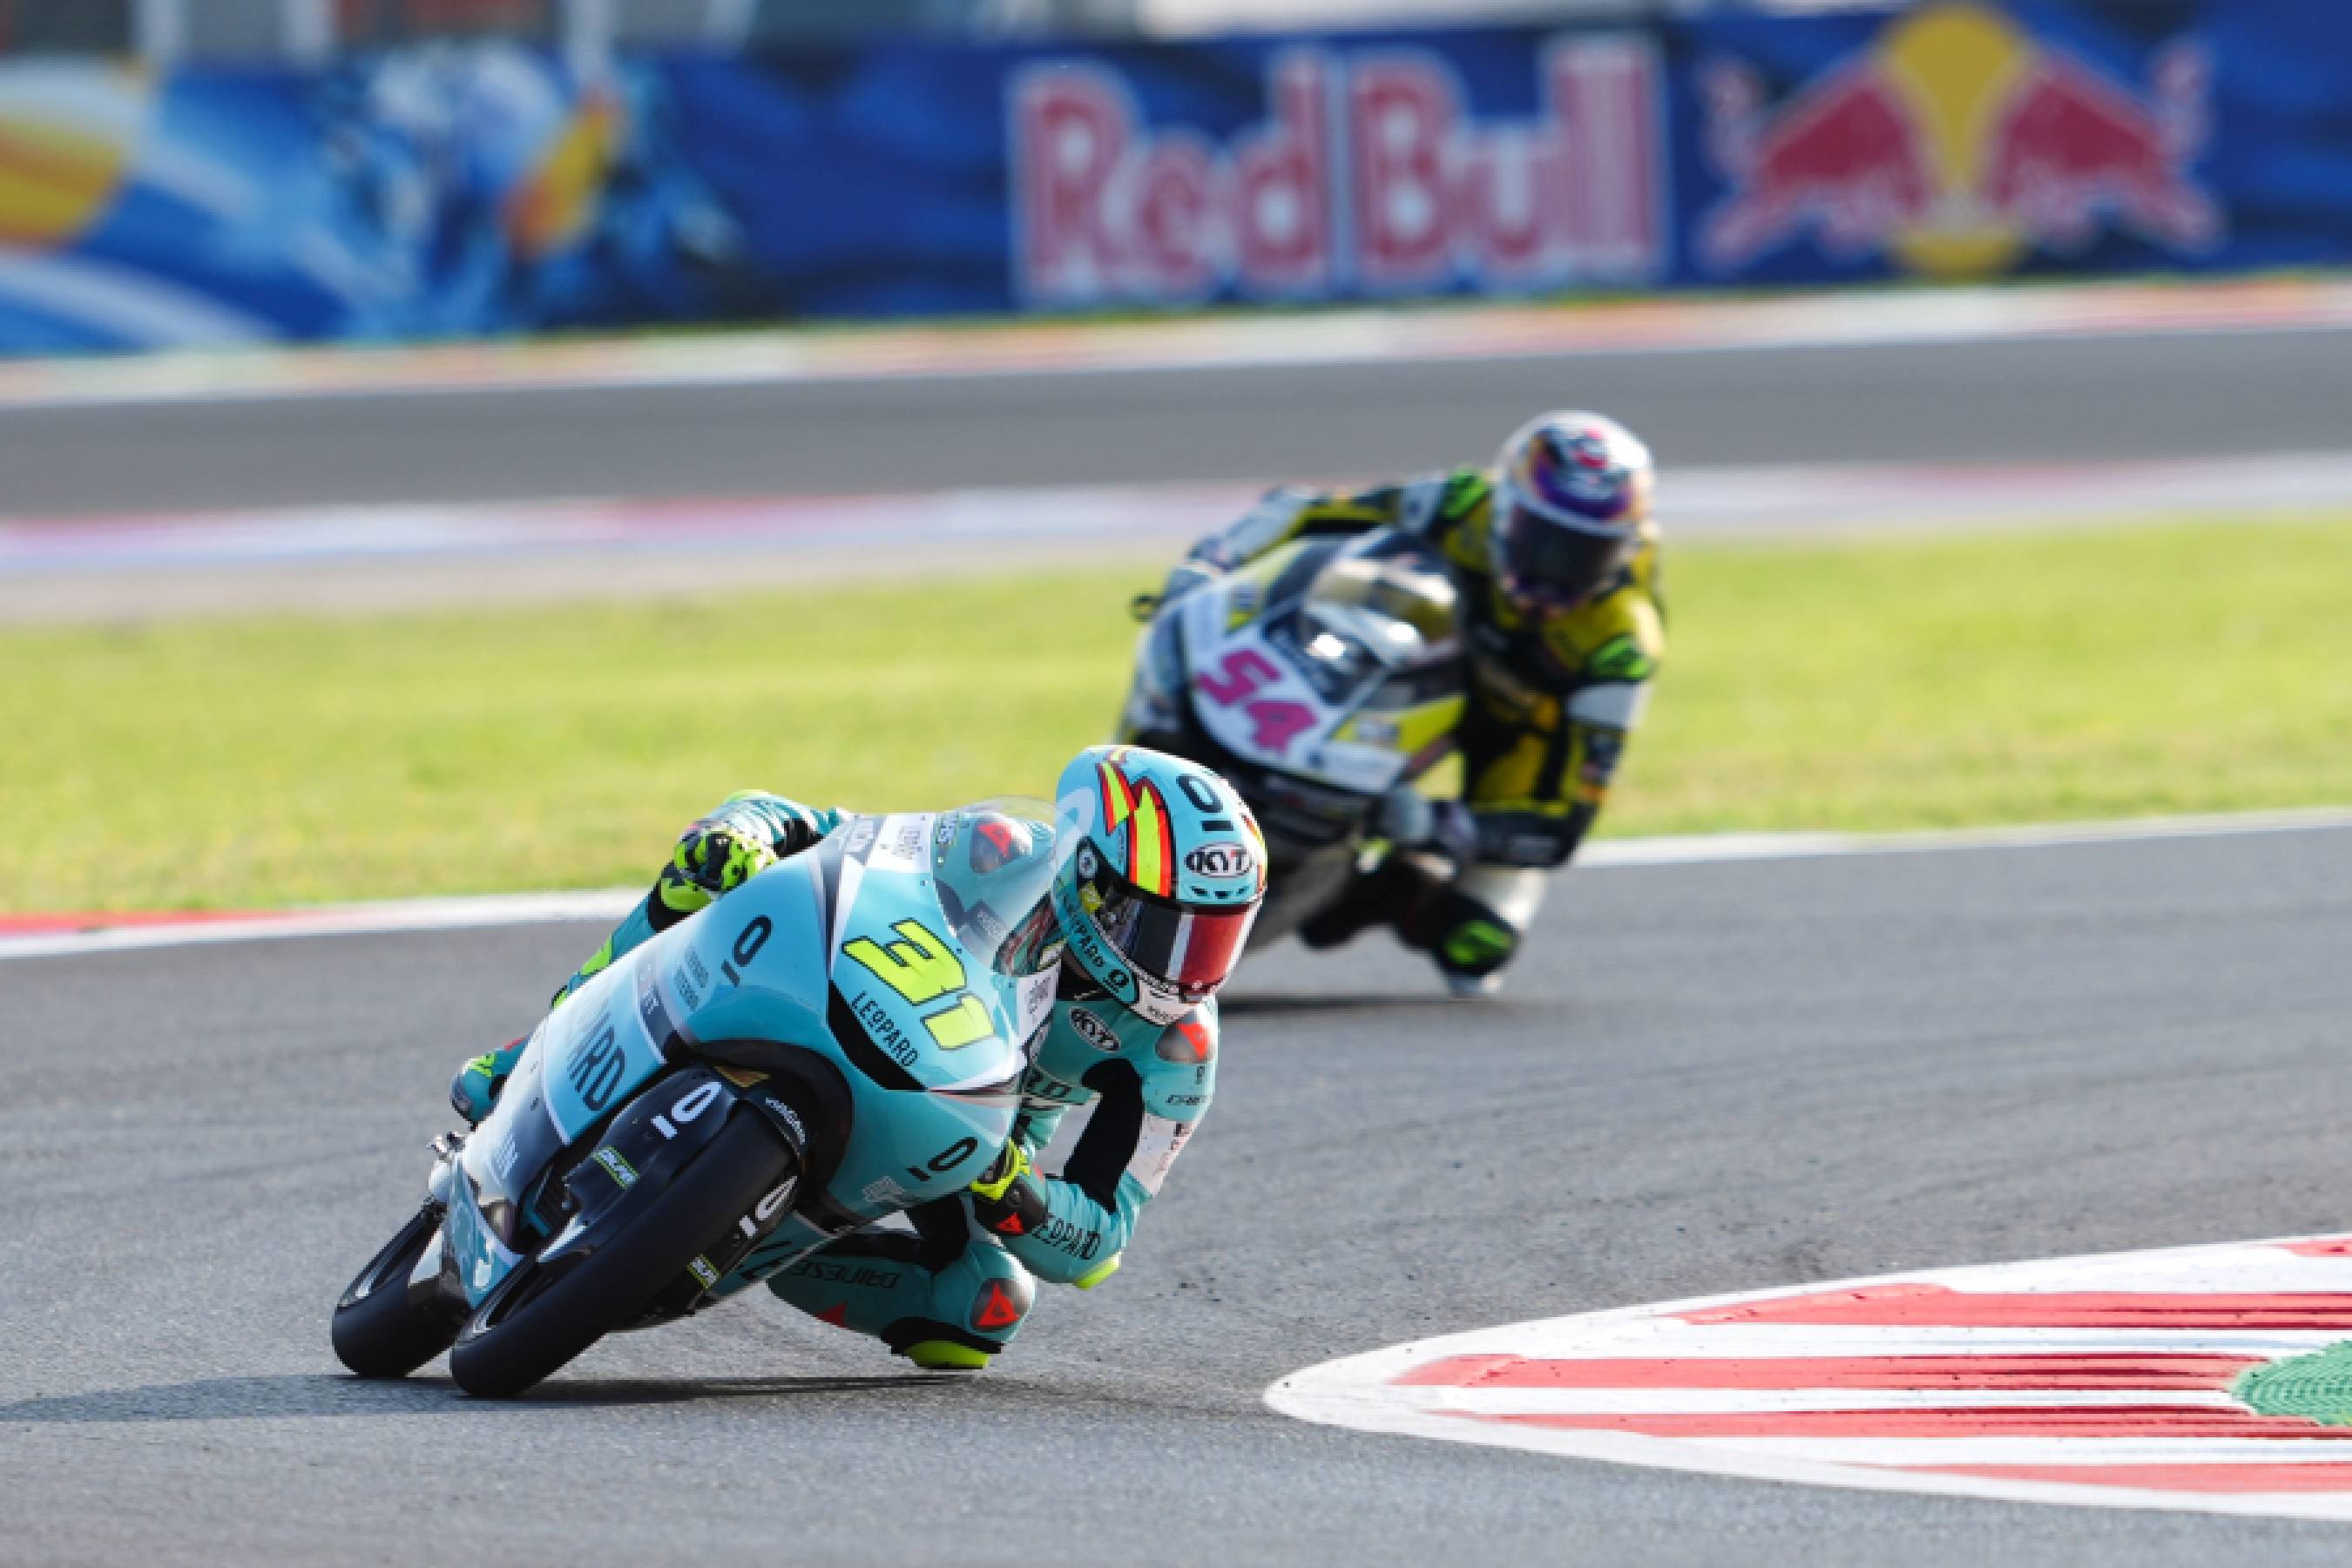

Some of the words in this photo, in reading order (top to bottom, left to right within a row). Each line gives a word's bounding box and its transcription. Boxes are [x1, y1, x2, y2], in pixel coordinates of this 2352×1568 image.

[1012, 68, 1331, 296] Red
[1347, 40, 1662, 293] Bull
[1197, 646, 1321, 754] 54
[1186, 849, 1252, 876] KYT
[841, 918, 994, 1051] 31
[851, 991, 919, 1067] LEOPARD
